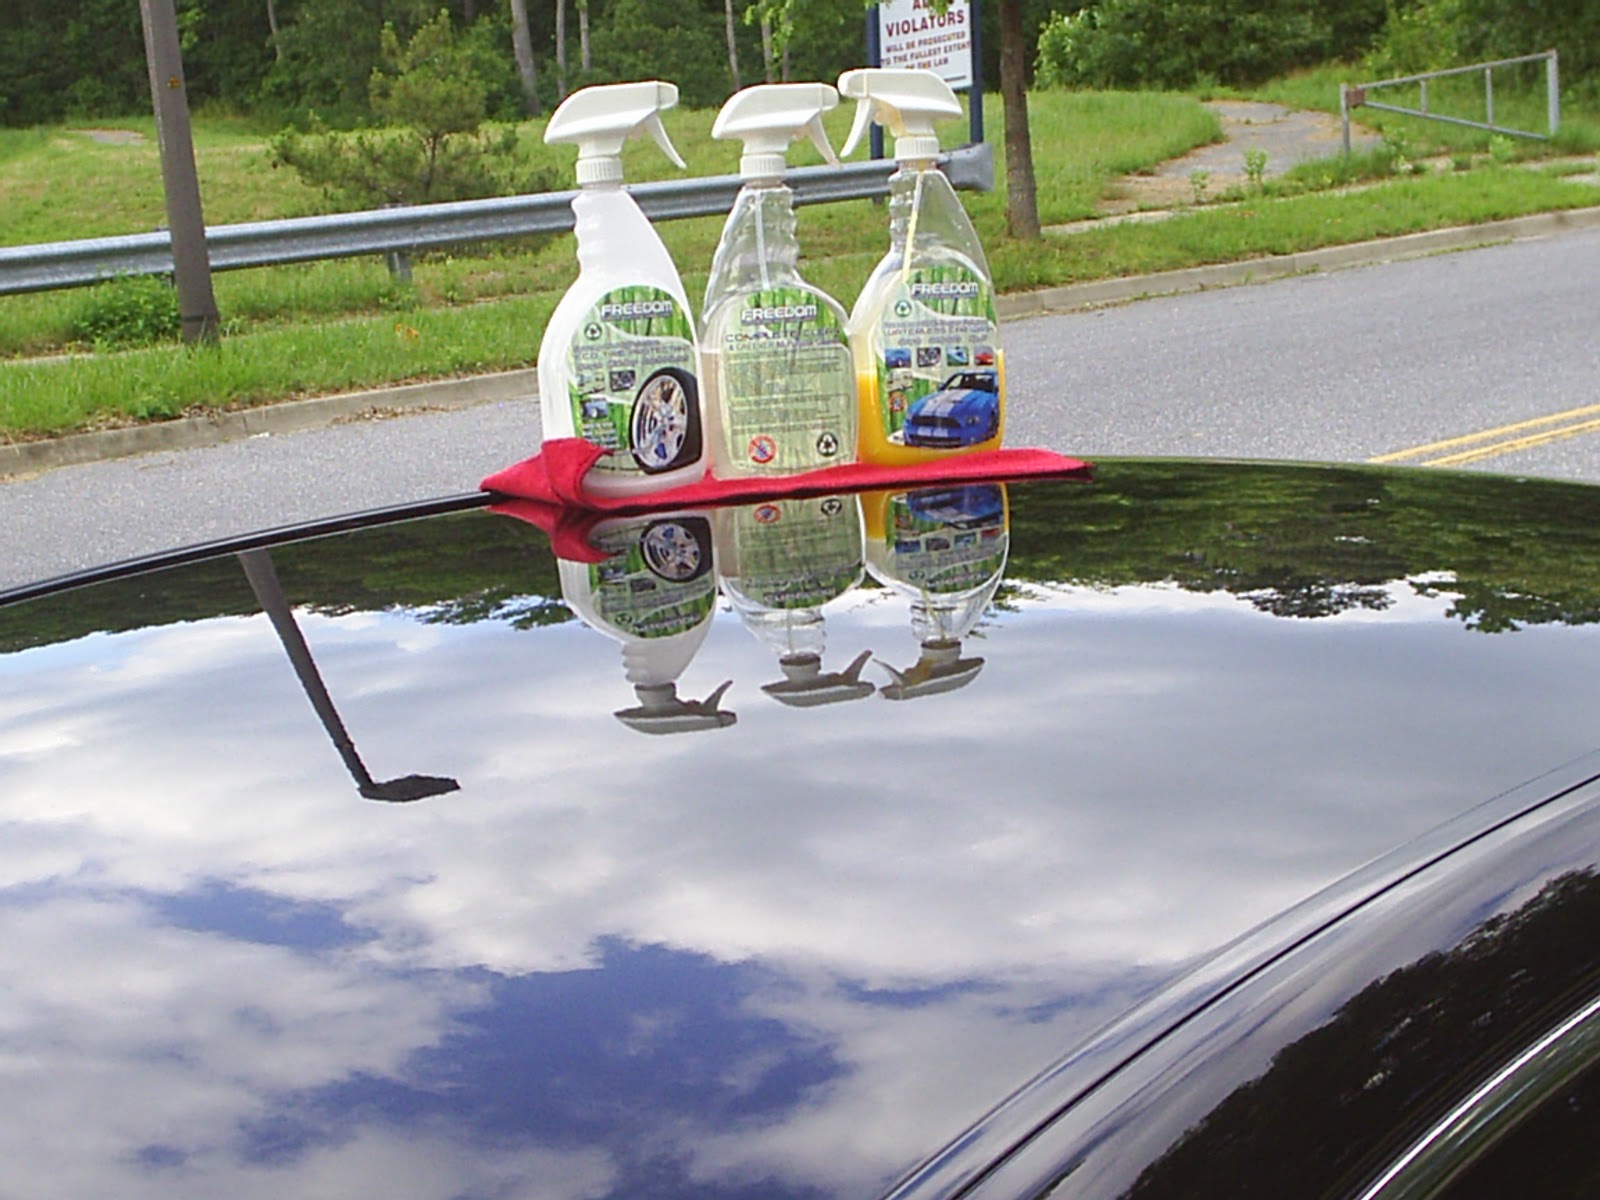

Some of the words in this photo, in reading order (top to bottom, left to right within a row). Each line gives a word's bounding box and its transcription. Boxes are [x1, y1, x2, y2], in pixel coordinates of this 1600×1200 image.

[886, 9, 965, 37] VIOLATORS
[886, 43, 904, 53] WILL
[906, 41, 916, 50] BE
[893, 54, 908, 63] THE
[910, 47, 942, 60] FULLEST
[944, 41, 971, 54] EXTENT
[934, 57, 949, 67] LAW
[912, 282, 978, 295] FREEDOM
[601, 301, 673, 317] FREEDOM
[742, 305, 817, 321] FREEDOM
